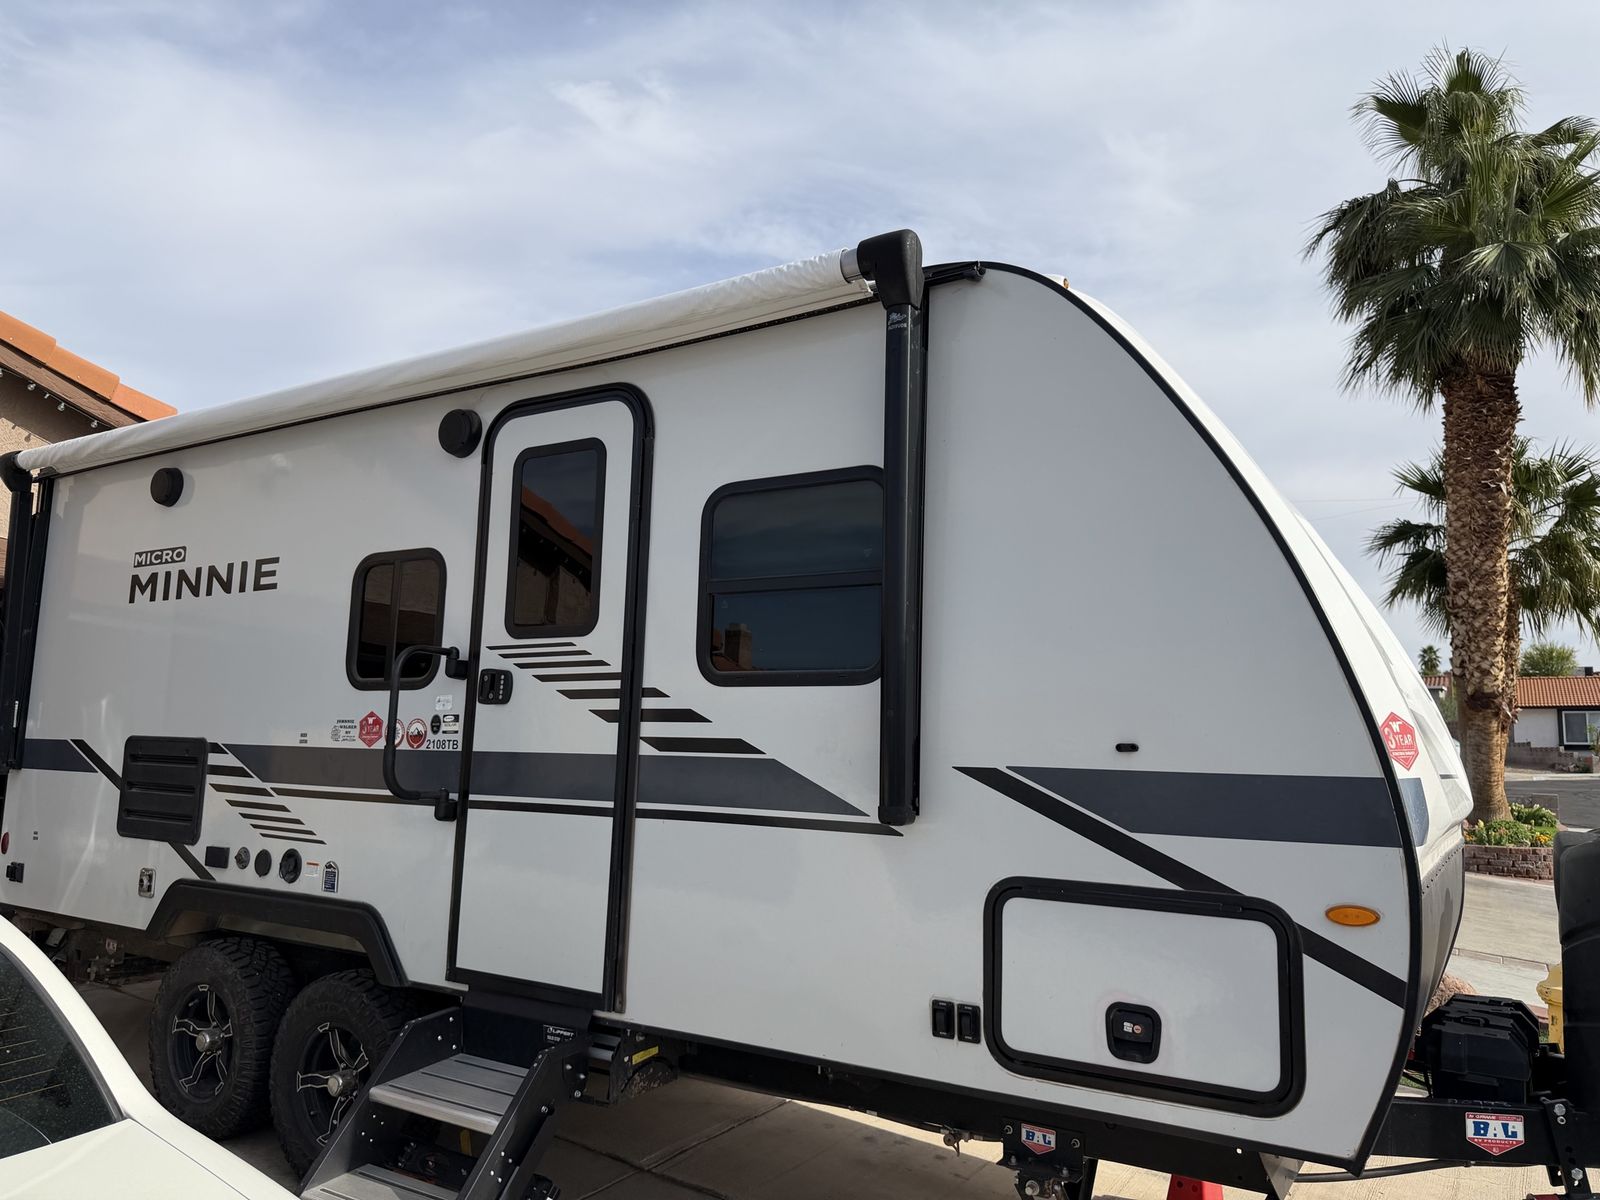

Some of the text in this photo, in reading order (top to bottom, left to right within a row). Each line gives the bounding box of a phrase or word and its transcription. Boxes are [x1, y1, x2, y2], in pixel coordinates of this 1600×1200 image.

[134, 547, 186, 567] MICRO
[129, 557, 280, 604] MINNIE
[362, 720, 368, 735] 3
[426, 739, 459, 750] 2108TB
[1383, 727, 1413, 749] 3 YEAR
[1472, 1120, 1518, 1139] BAL
